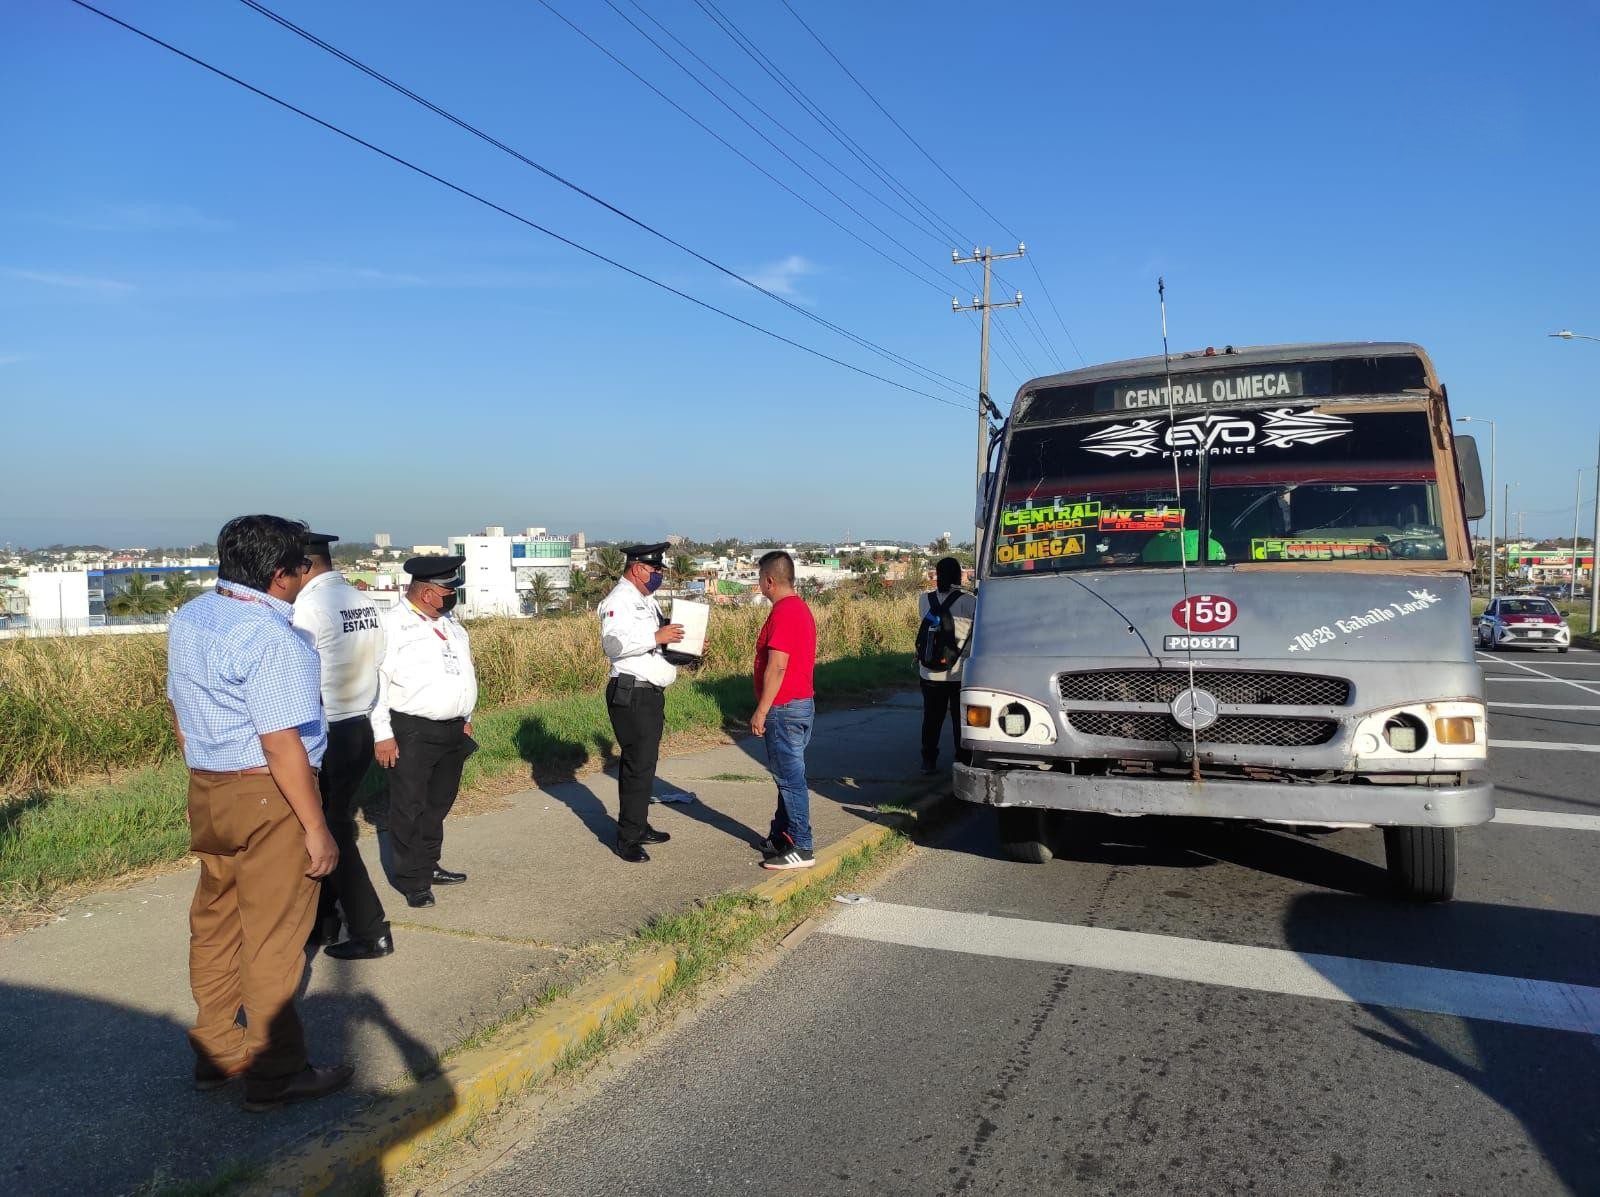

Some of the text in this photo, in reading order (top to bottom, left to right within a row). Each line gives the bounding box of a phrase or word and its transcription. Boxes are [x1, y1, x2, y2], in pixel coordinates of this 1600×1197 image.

[1125, 371, 1290, 408] CENTRAL OLMECA
[1164, 415, 1256, 450] EVO
[1004, 503, 1098, 525] CENTRAL
[1017, 518, 1082, 533] ALAMEDA
[999, 537, 1082, 562] OLMECA
[1286, 544, 1389, 559] QUEVEDO
[339, 606, 377, 621] TRANSPORTE
[1179, 601, 1232, 624] 159
[343, 617, 379, 633] ESTATAL
[1293, 625, 1336, 652] 10:28
[1389, 598, 1430, 616] Loco
[1168, 637, 1236, 649] P006171
